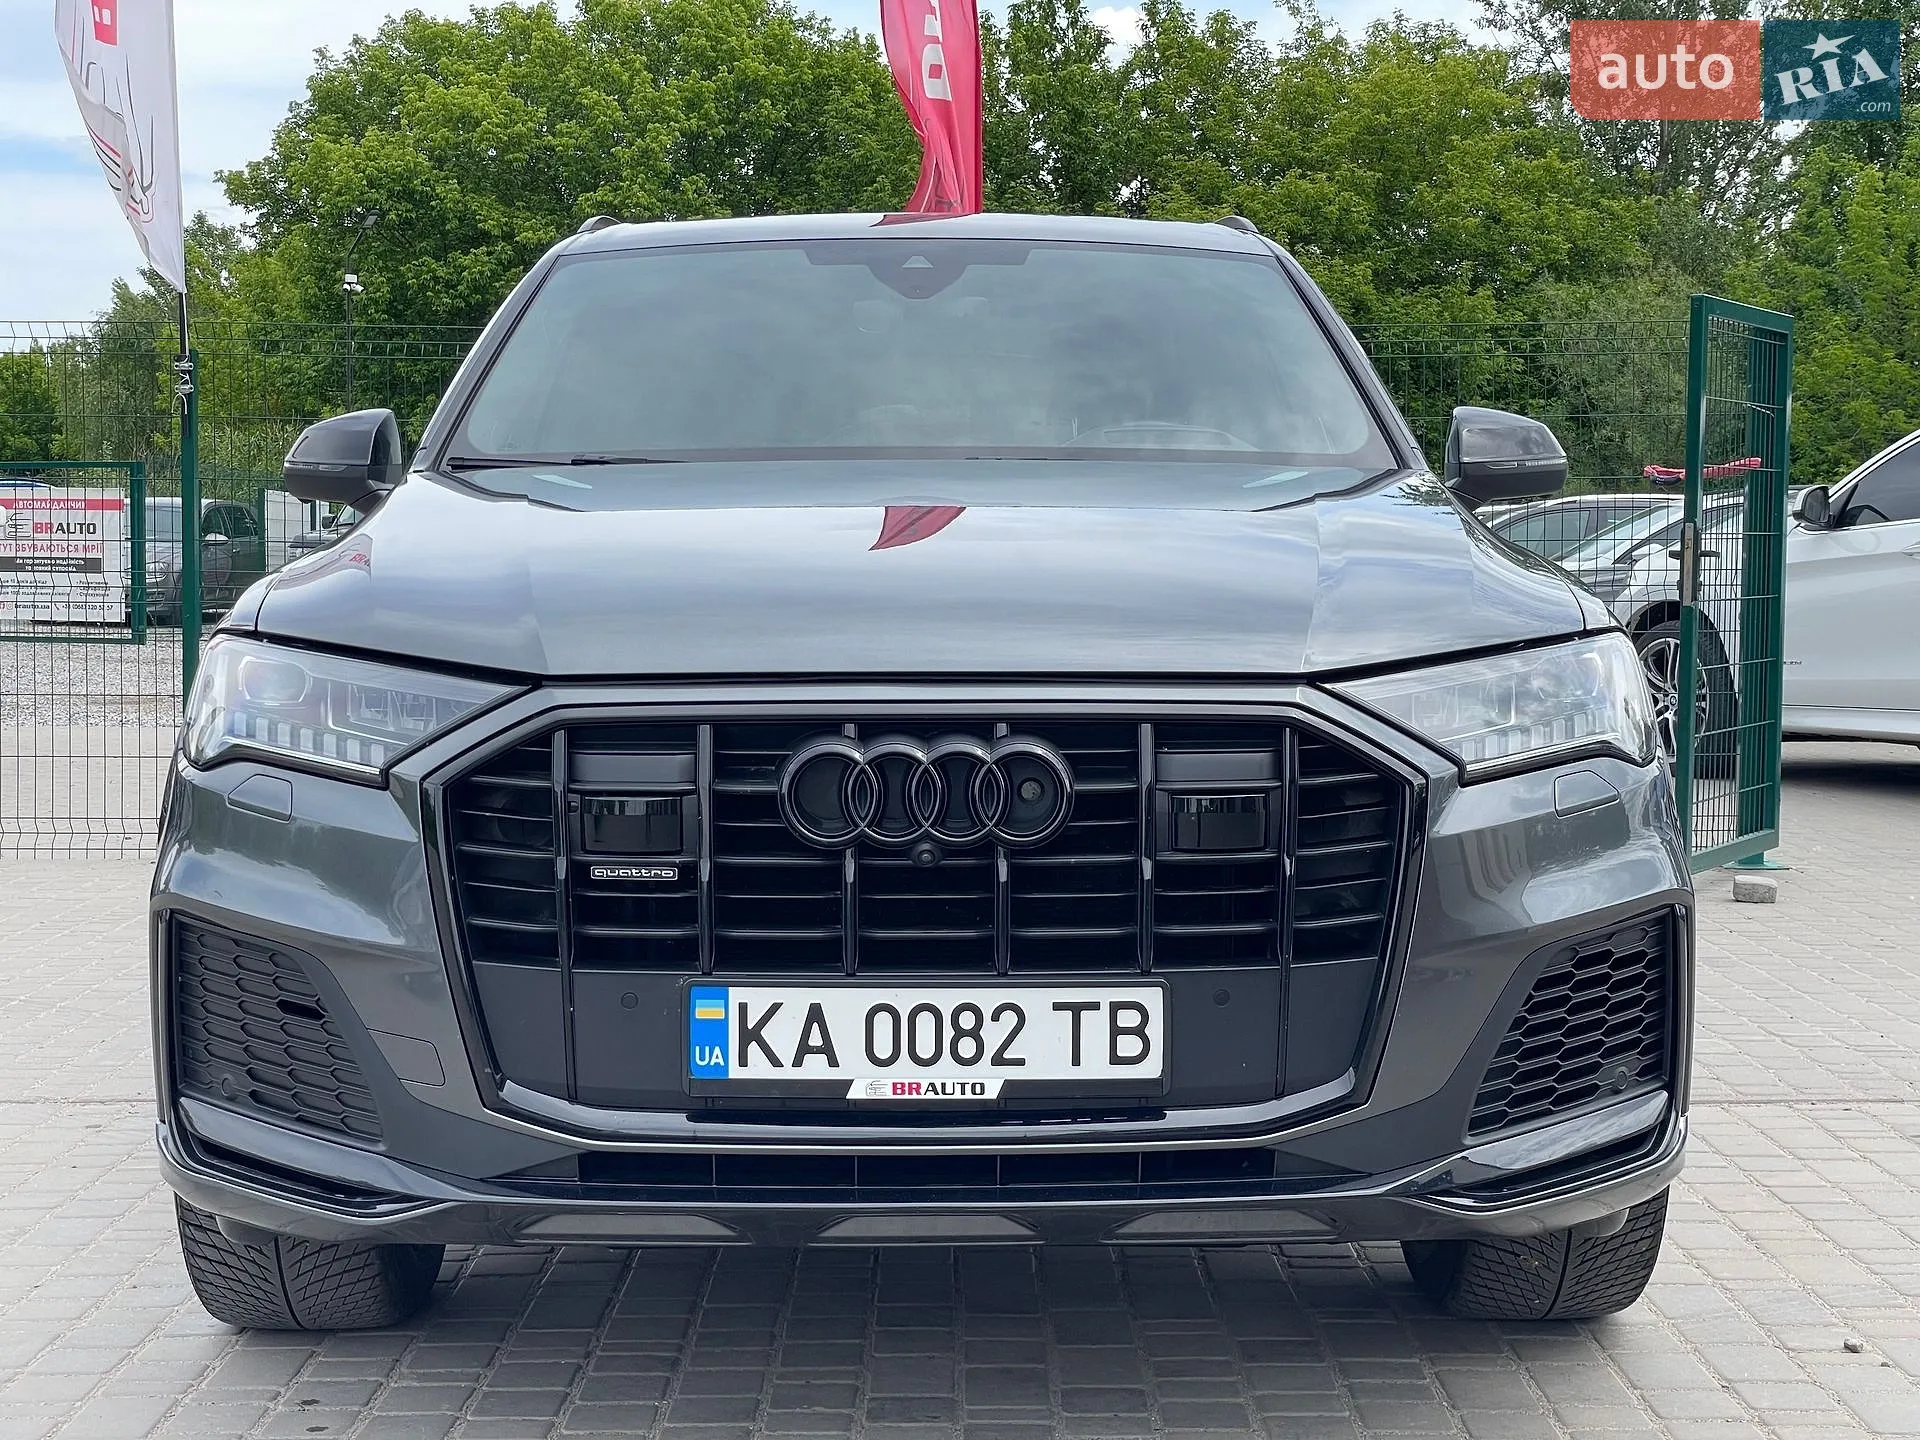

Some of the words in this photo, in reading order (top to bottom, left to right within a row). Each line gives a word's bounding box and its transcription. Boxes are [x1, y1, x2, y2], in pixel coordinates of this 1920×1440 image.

[33, 521, 97, 535] BRAUTO
[16, 543, 79, 553] ЗБУВАЮТЬСЯ
[594, 868, 674, 878] quattro
[695, 1045, 725, 1067] UA
[737, 1001, 840, 1068] KA
[864, 1001, 1027, 1067] 0082
[1052, 1000, 1151, 1067] TB
[891, 1079, 986, 1097] BRAUTO
